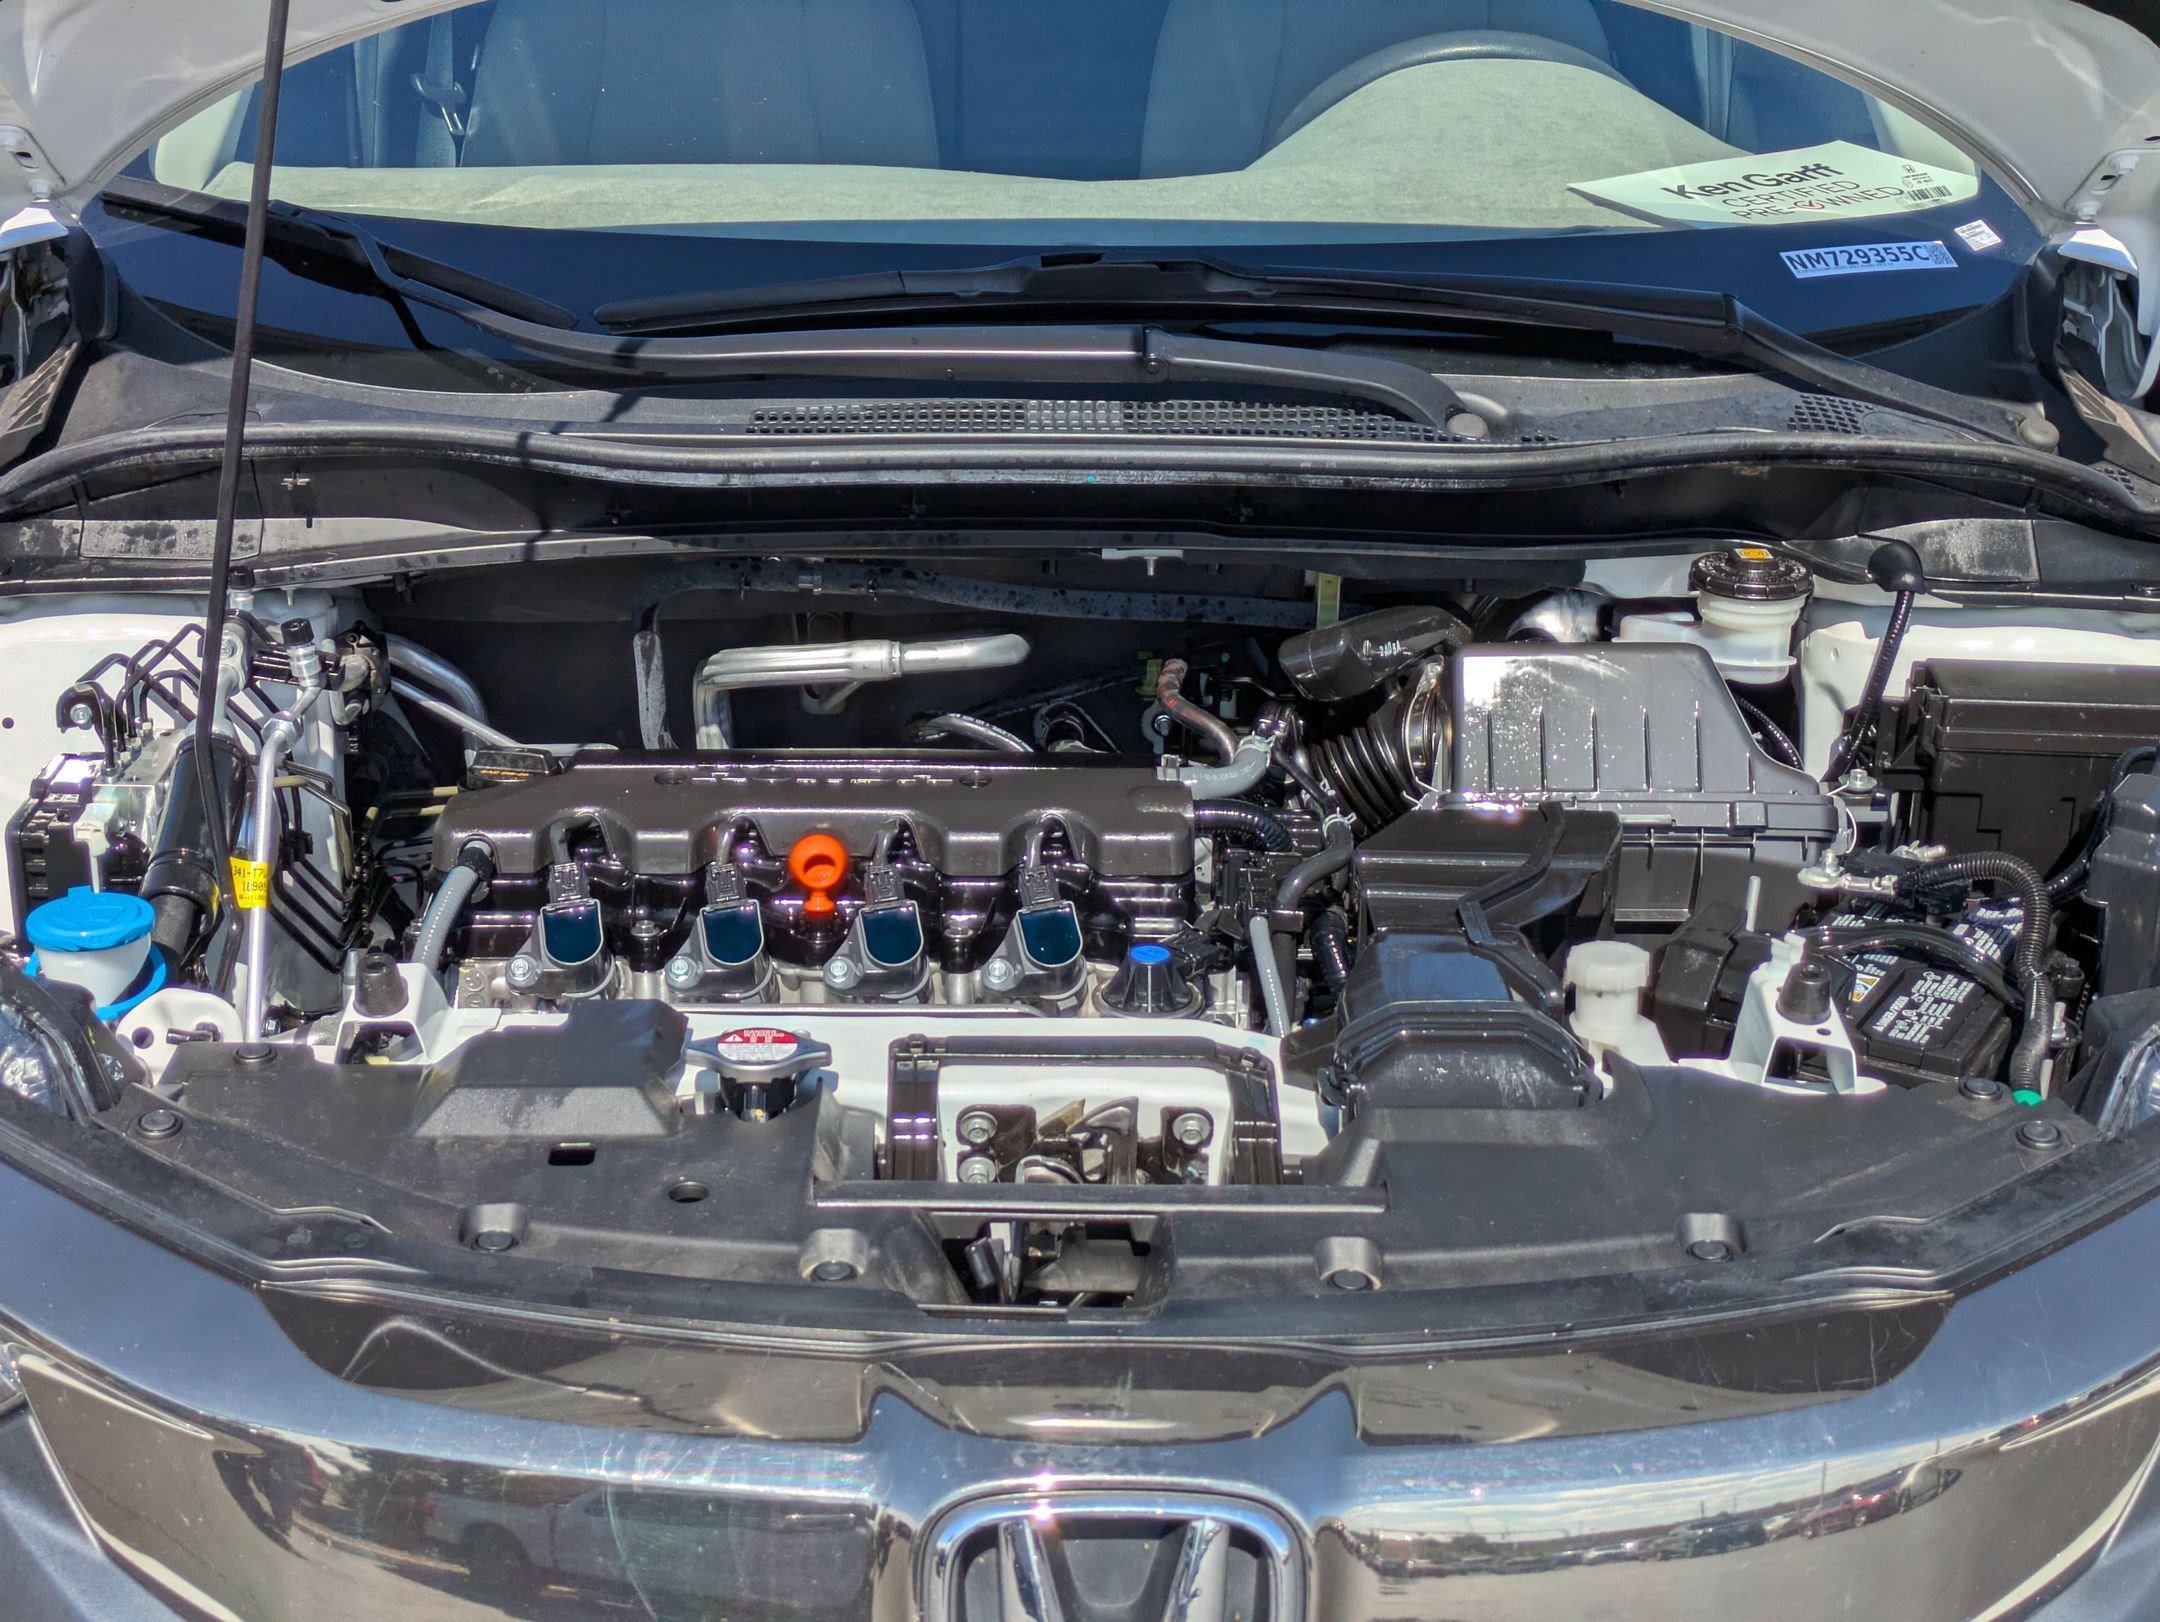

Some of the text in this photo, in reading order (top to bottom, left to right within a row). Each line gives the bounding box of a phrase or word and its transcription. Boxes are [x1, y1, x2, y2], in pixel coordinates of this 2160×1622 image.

[1660, 180, 1754, 200] Ken
[1722, 180, 1860, 208] CERTIFIED
[1785, 245, 1930, 271] NM729355C
